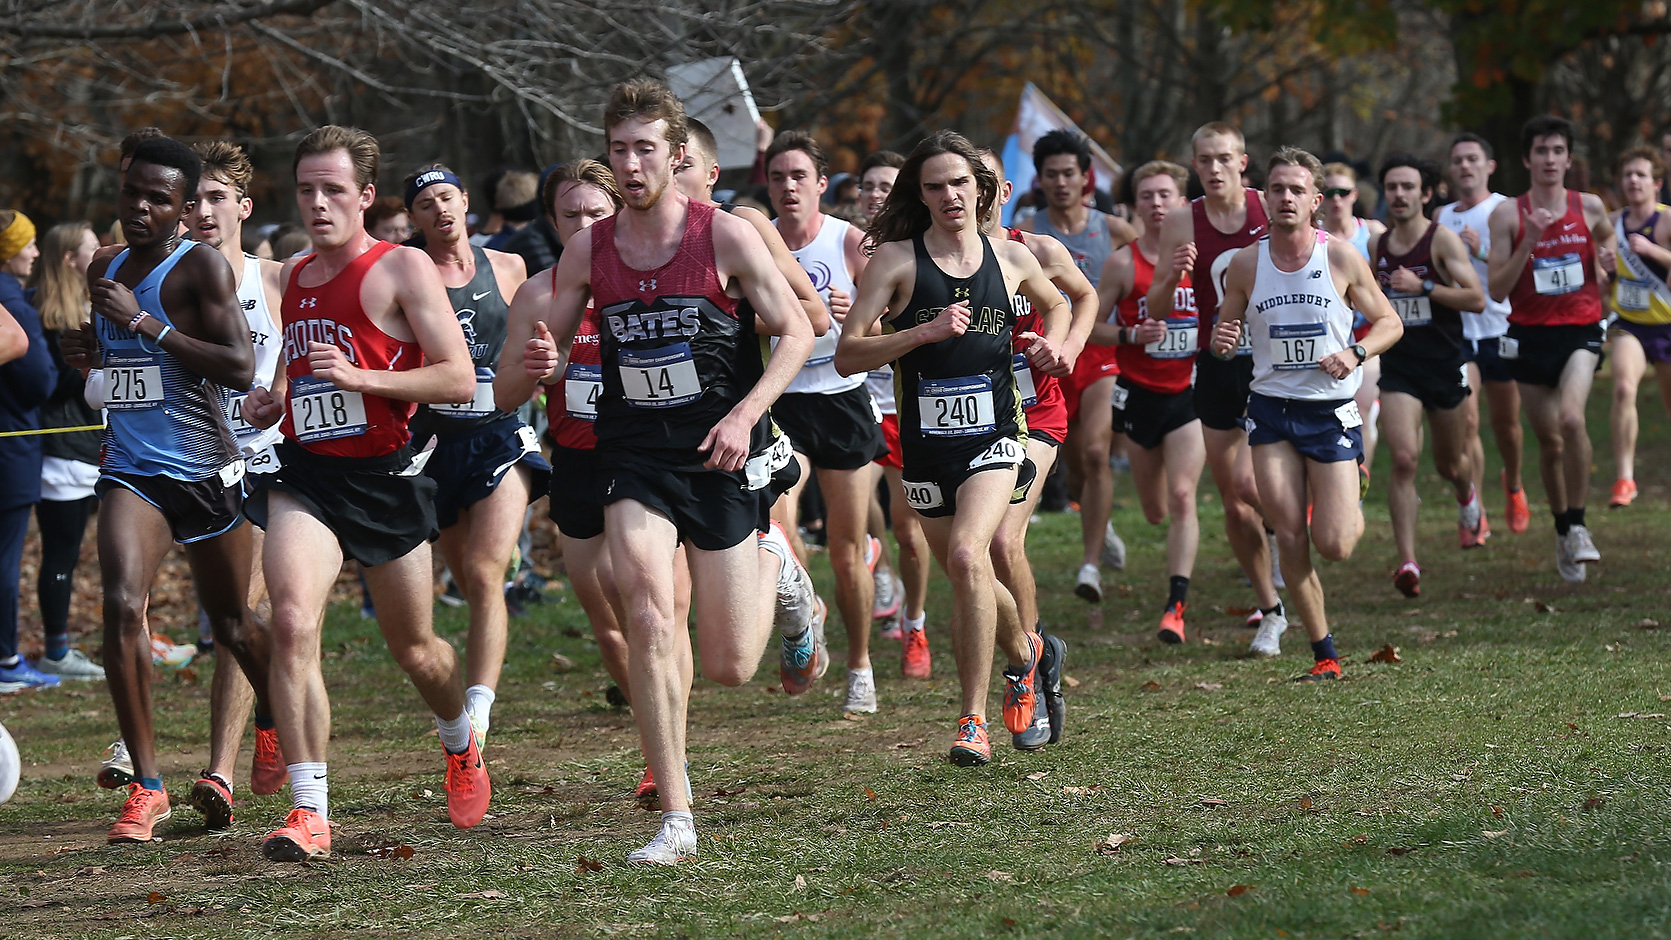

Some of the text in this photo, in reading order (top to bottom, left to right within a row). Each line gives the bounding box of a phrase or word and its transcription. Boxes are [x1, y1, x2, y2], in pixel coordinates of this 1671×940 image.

[415, 171, 446, 188] CWRU
[1551, 269, 1570, 287] 41
[1255, 293, 1332, 315] MIDDLEBURY
[607, 307, 701, 343] BATES
[283, 318, 356, 366] HODES
[1282, 339, 1316, 363] 167
[111, 369, 147, 400] 275
[640, 367, 675, 399] 14
[302, 392, 348, 431] 218
[935, 395, 979, 428] 240
[981, 441, 1016, 461] 240
